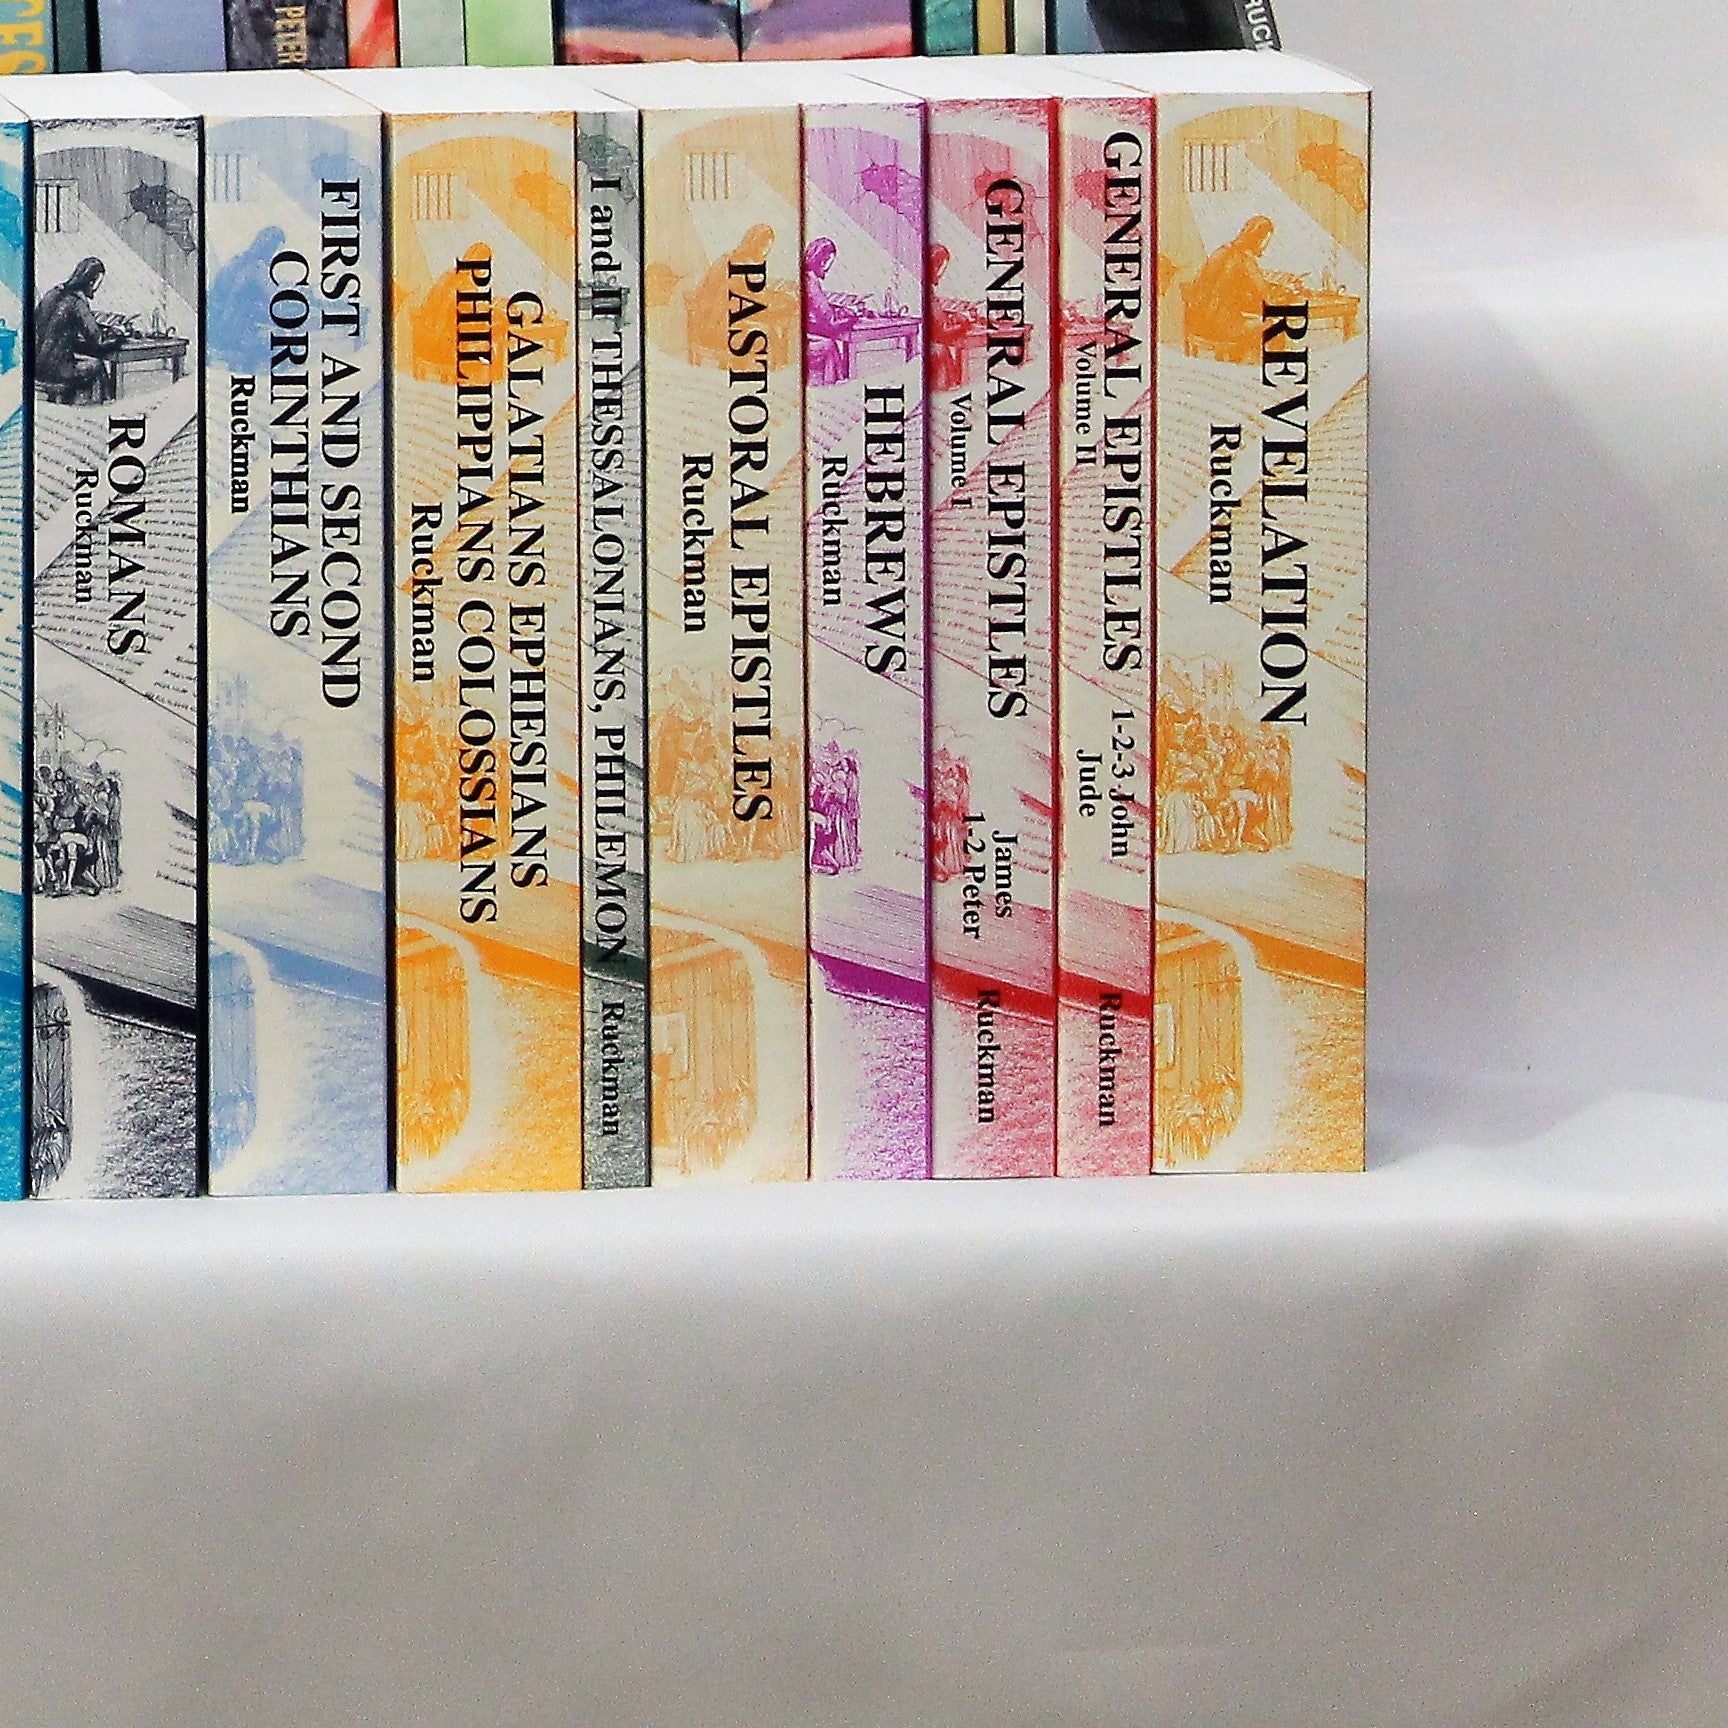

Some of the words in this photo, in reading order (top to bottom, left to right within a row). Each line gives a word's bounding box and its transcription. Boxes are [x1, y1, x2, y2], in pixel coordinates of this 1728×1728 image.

[320, 177, 361, 340] FIRST
[592, 203, 622, 278] and
[1102, 131, 1143, 399] GENERAL
[230, 375, 255, 514] Ruckman
[268, 250, 310, 639] CORINTHIANS
[321, 352, 361, 469] AND
[456, 257, 495, 583] PHILIPPIANS
[505, 291, 546, 588] GALATIANS
[1075, 342, 1096, 436] Volume
[1077, 446, 1096, 465] II
[106, 416, 147, 657] ROMANS
[320, 483, 362, 709] SECOND
[409, 502, 444, 683] Ruckman
[589, 329, 625, 713] THESSALONIANS,
[822, 457, 847, 606] Ruckman
[863, 385, 907, 674] HEBREWS
[1102, 415, 1143, 672] EPISTLES
[1210, 424, 1242, 604] Ruckman
[1260, 300, 1309, 726] REVELATION
[457, 599, 498, 924] COLOSSIANS
[508, 602, 549, 888] EPHESIANS
[592, 725, 628, 965] PHILEMON
[1077, 750, 1101, 817] Jude
[1110, 789, 1132, 858] John
[601, 1001, 626, 1136] Ruckman
[1099, 993, 1121, 1127] Ruckman
